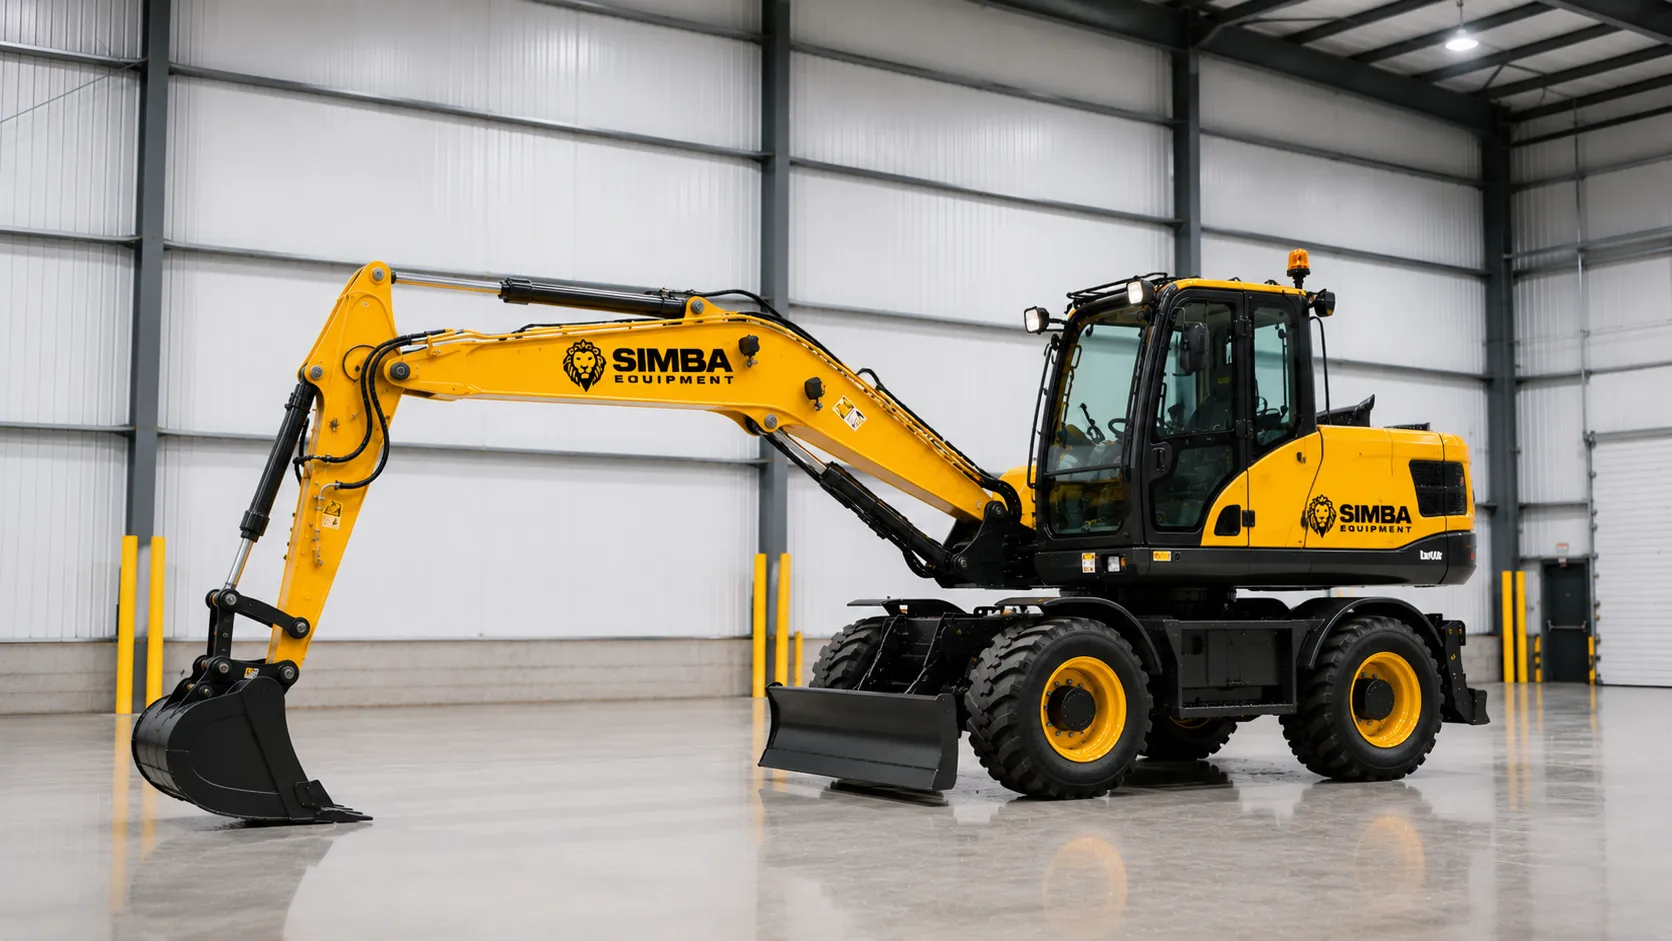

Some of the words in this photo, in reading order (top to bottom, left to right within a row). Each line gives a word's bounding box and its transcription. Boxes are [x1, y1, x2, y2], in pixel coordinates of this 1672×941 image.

[612, 348, 734, 373] SIMBA
[614, 374, 734, 385] EQUIPMENT
[1339, 504, 1412, 524] SIMBA
[1339, 524, 1412, 533] EQUIPMENT
